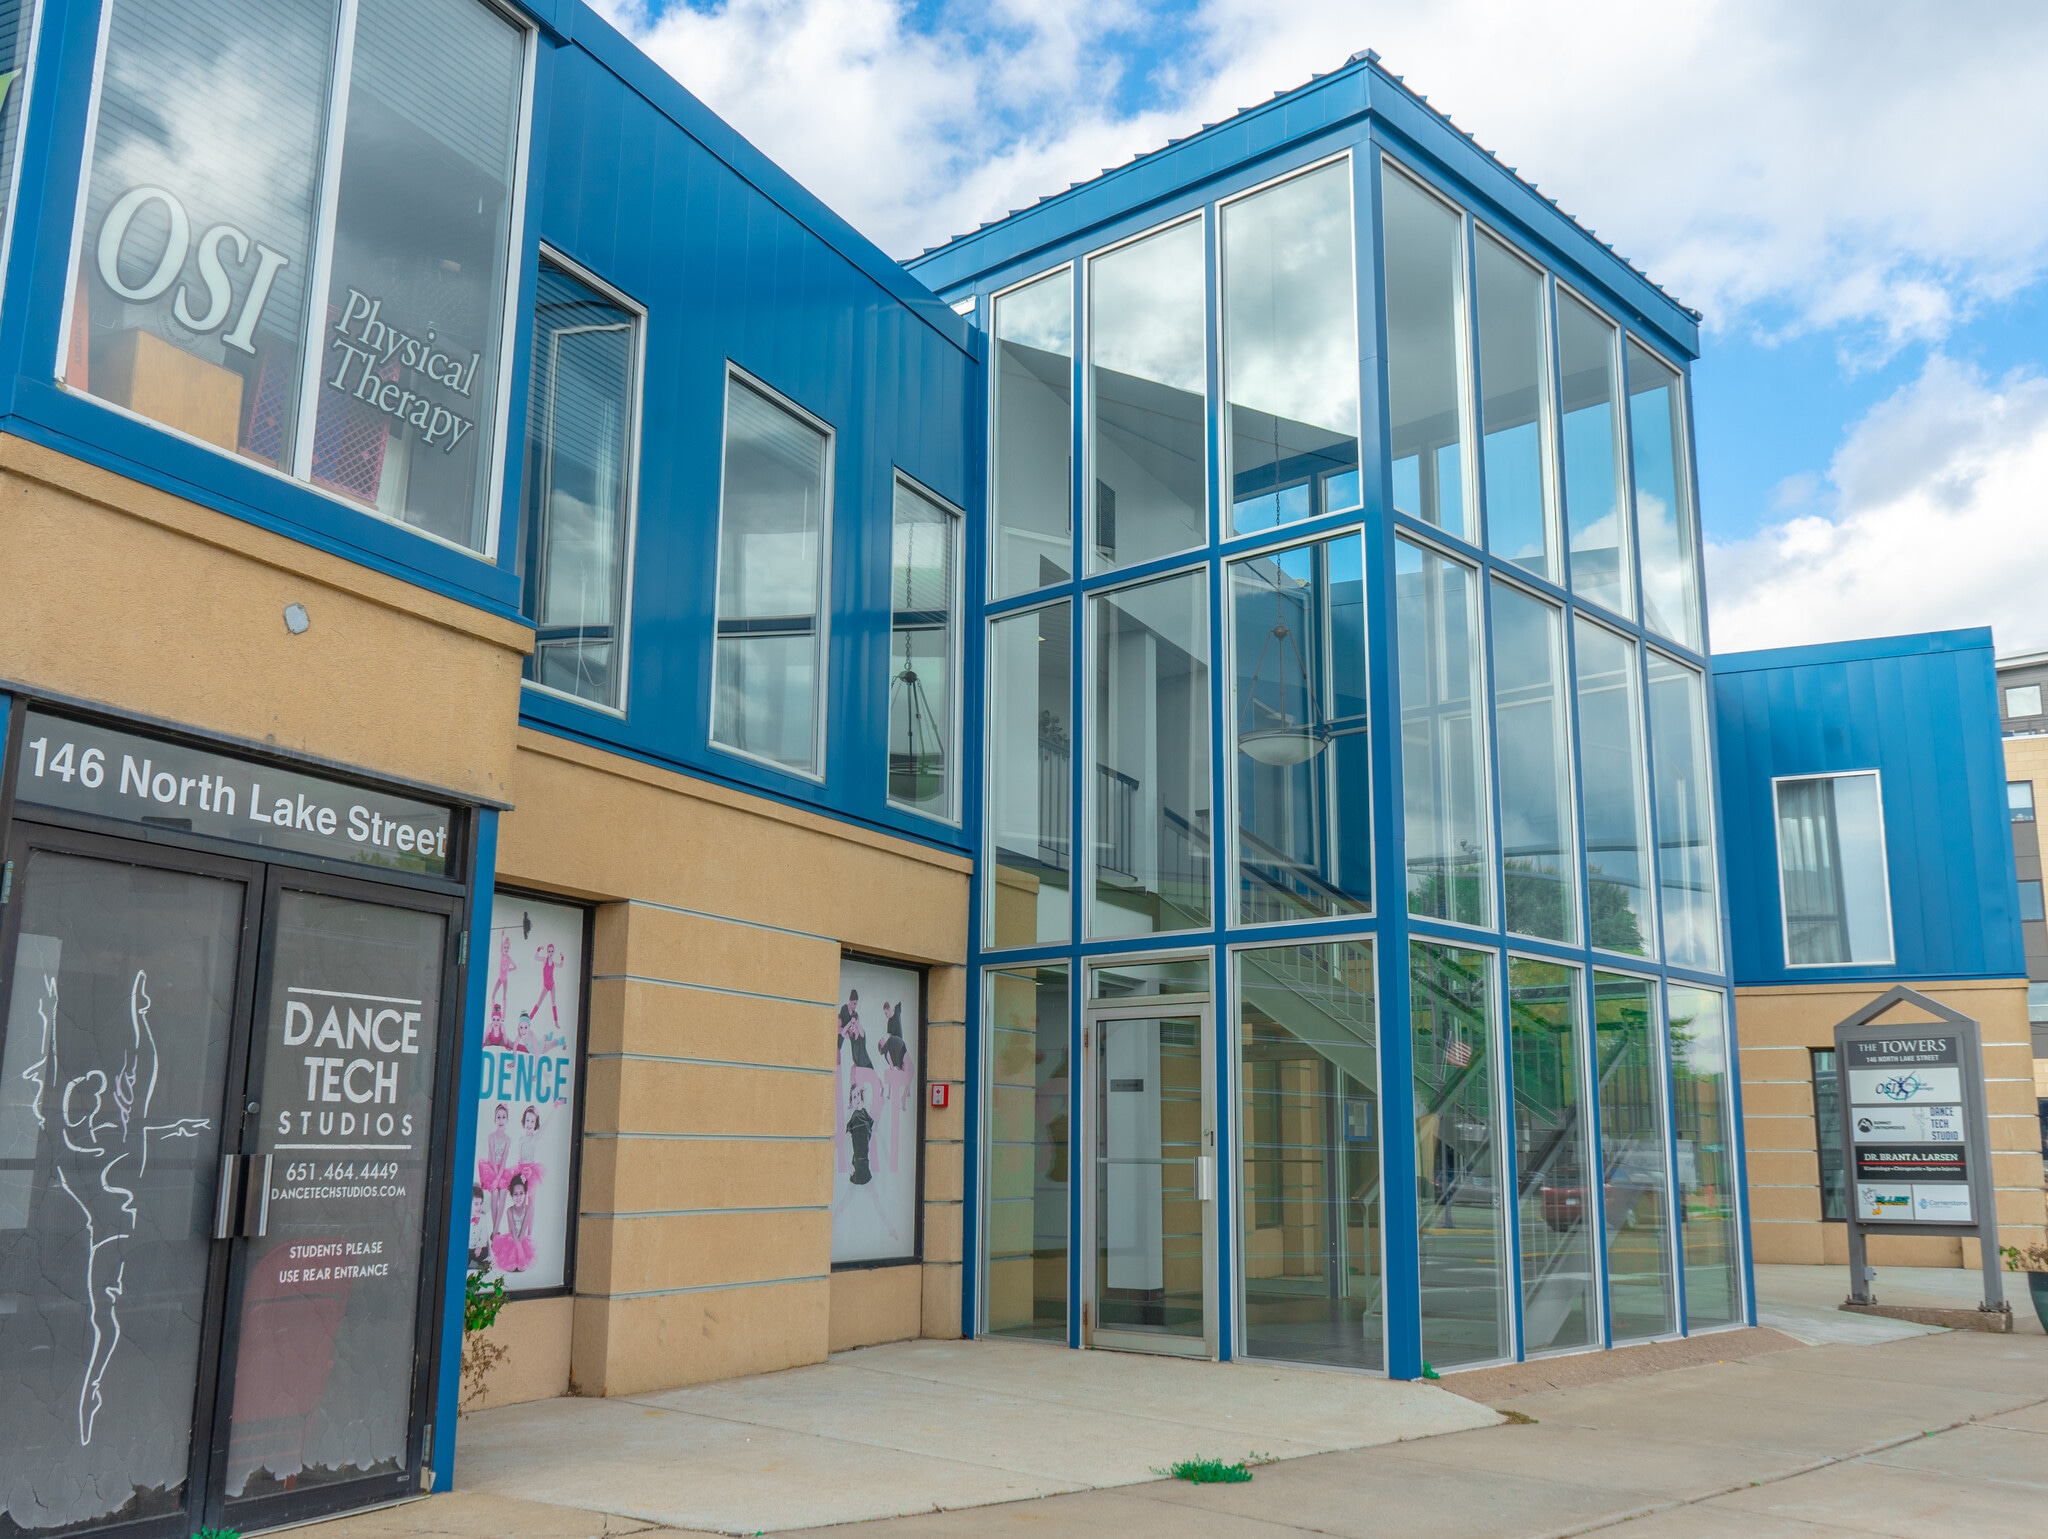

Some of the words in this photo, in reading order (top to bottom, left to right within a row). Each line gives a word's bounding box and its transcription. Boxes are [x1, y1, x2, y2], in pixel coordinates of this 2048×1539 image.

[98, 186, 290, 355] OSI
[335, 288, 481, 396] Physical
[328, 337, 473, 454] Therapy
[29, 736, 106, 788] 146
[119, 754, 236, 816] North
[249, 783, 338, 836] Lake
[346, 804, 447, 858] Street
[283, 1000, 422, 1054] DANCE
[1858, 1043, 1878, 1052] THE
[1879, 1038, 1947, 1053] TOWERS
[303, 1056, 399, 1104] TECH
[479, 1050, 569, 1104] DENCE
[1875, 1082, 1896, 1095] OSI
[1930, 1106, 1954, 1116] DANCE
[277, 1110, 413, 1136] STUDIOS
[1931, 1118, 1949, 1128] TECH
[1932, 1130, 1959, 1141] STUDIO
[1863, 1153, 1879, 1161] DR.
[1880, 1153, 1911, 1161] BRANT
[1912, 1153, 1921, 1161] A.
[1922, 1153, 1958, 1161] LARSEN
[286, 1161, 399, 1181] 651.464.4449
[271, 1184, 407, 1201] DANCETECHSTUDIOS.COM
[289, 1243, 343, 1259] STUDENTS
[345, 1241, 384, 1255] PLEASE
[279, 1269, 300, 1284] USE
[302, 1267, 331, 1282] REAR
[334, 1263, 389, 1279] ENTRANCE
